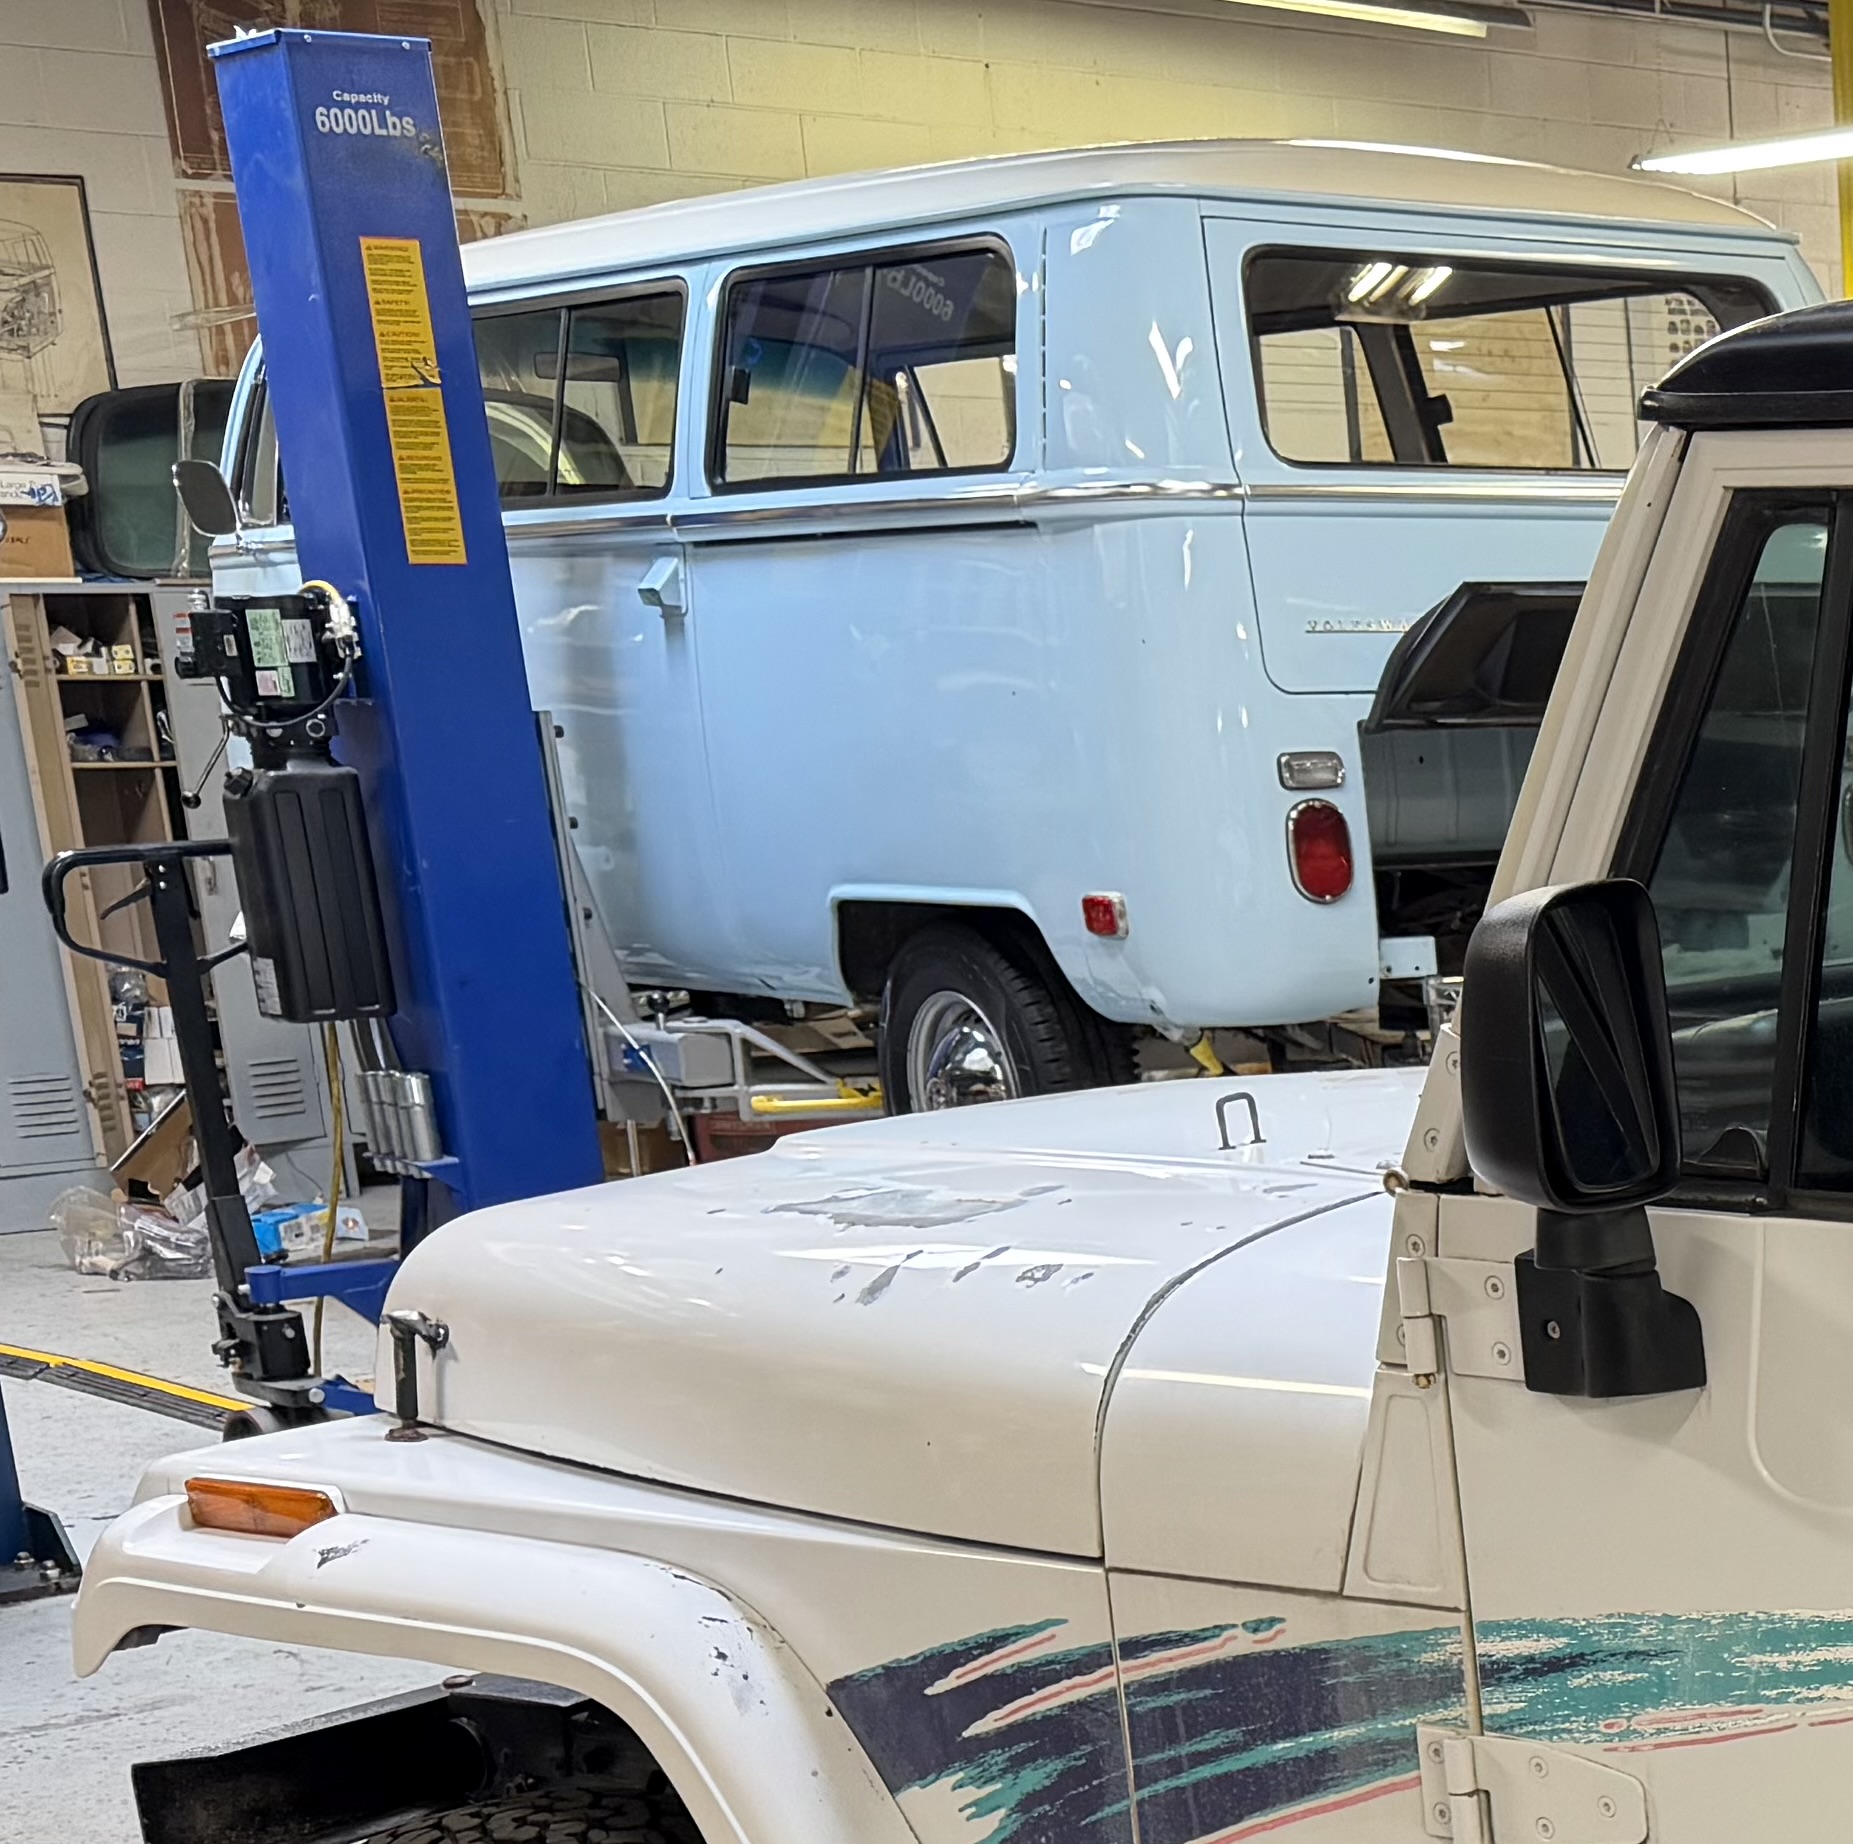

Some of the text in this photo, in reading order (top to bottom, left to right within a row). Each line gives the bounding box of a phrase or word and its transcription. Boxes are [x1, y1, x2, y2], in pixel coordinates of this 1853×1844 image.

[332, 90, 390, 105] Capacity
[315, 106, 417, 137] 6000Lbs
[1307, 619, 1409, 631] VOLKSWA
